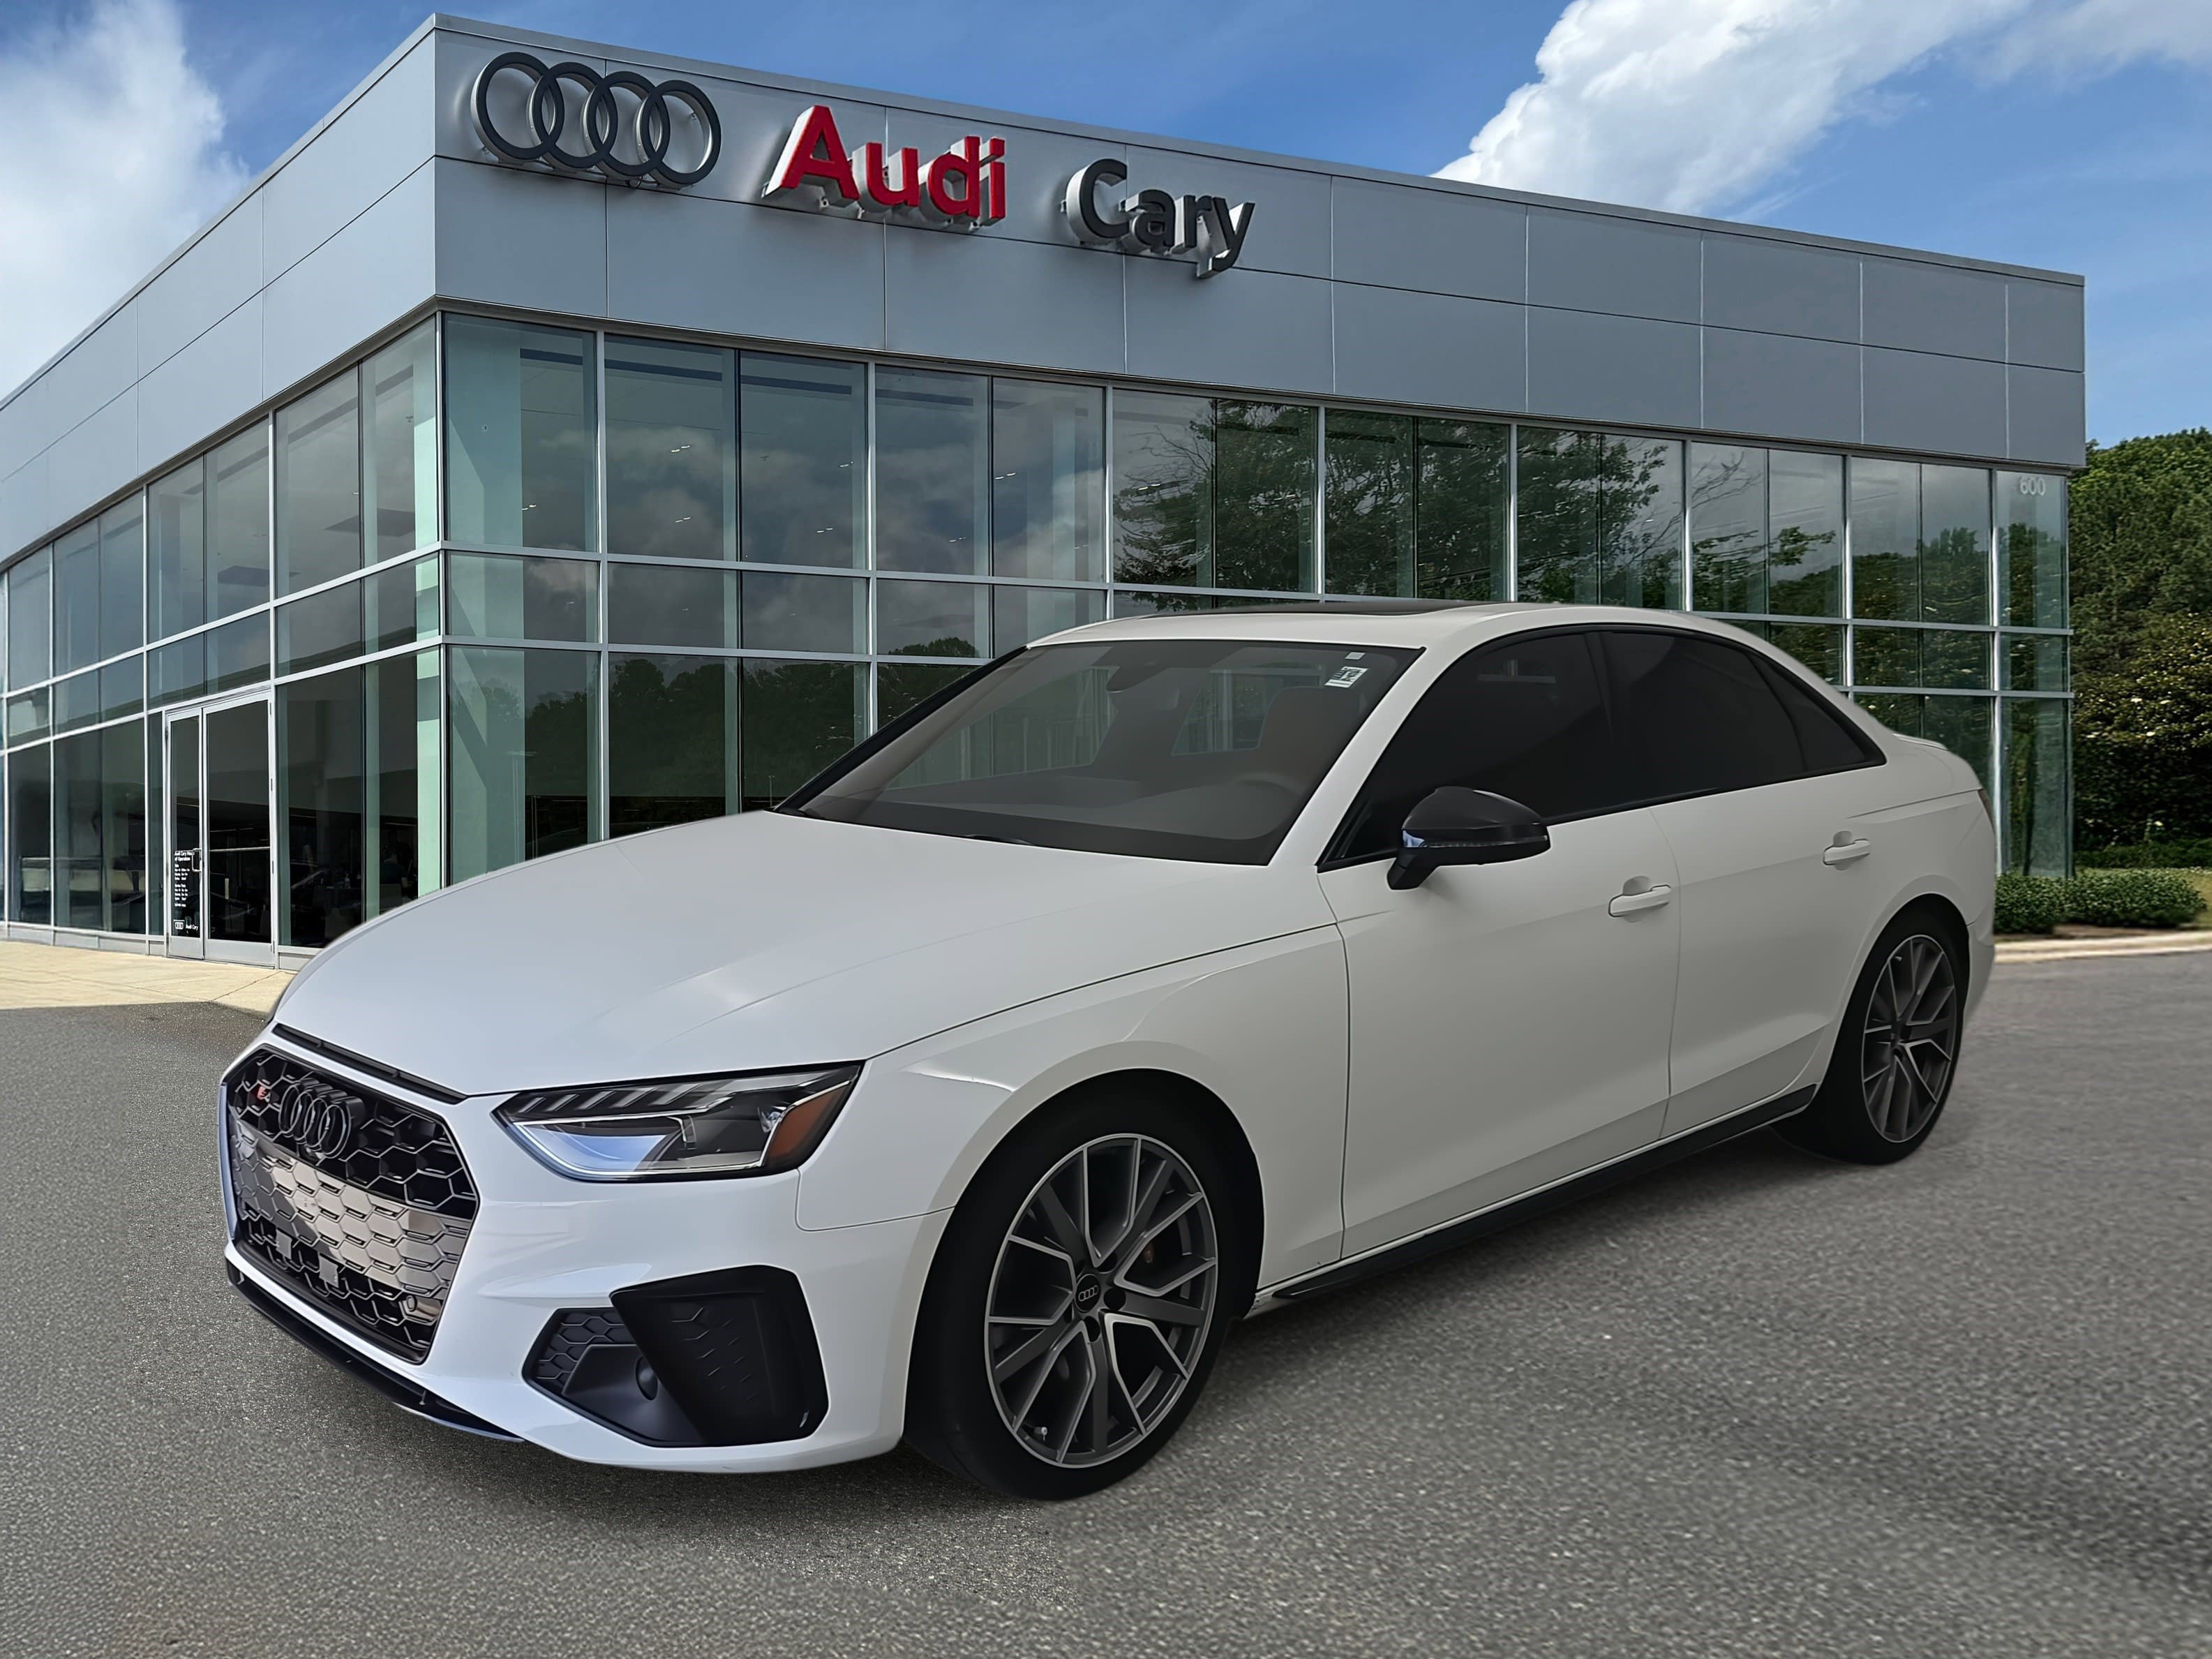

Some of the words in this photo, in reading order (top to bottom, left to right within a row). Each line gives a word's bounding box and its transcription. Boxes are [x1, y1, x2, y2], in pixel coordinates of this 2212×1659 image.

[763, 105, 1006, 226] Audi
[1061, 158, 1255, 278] Cary
[2020, 476, 2045, 496] 600
